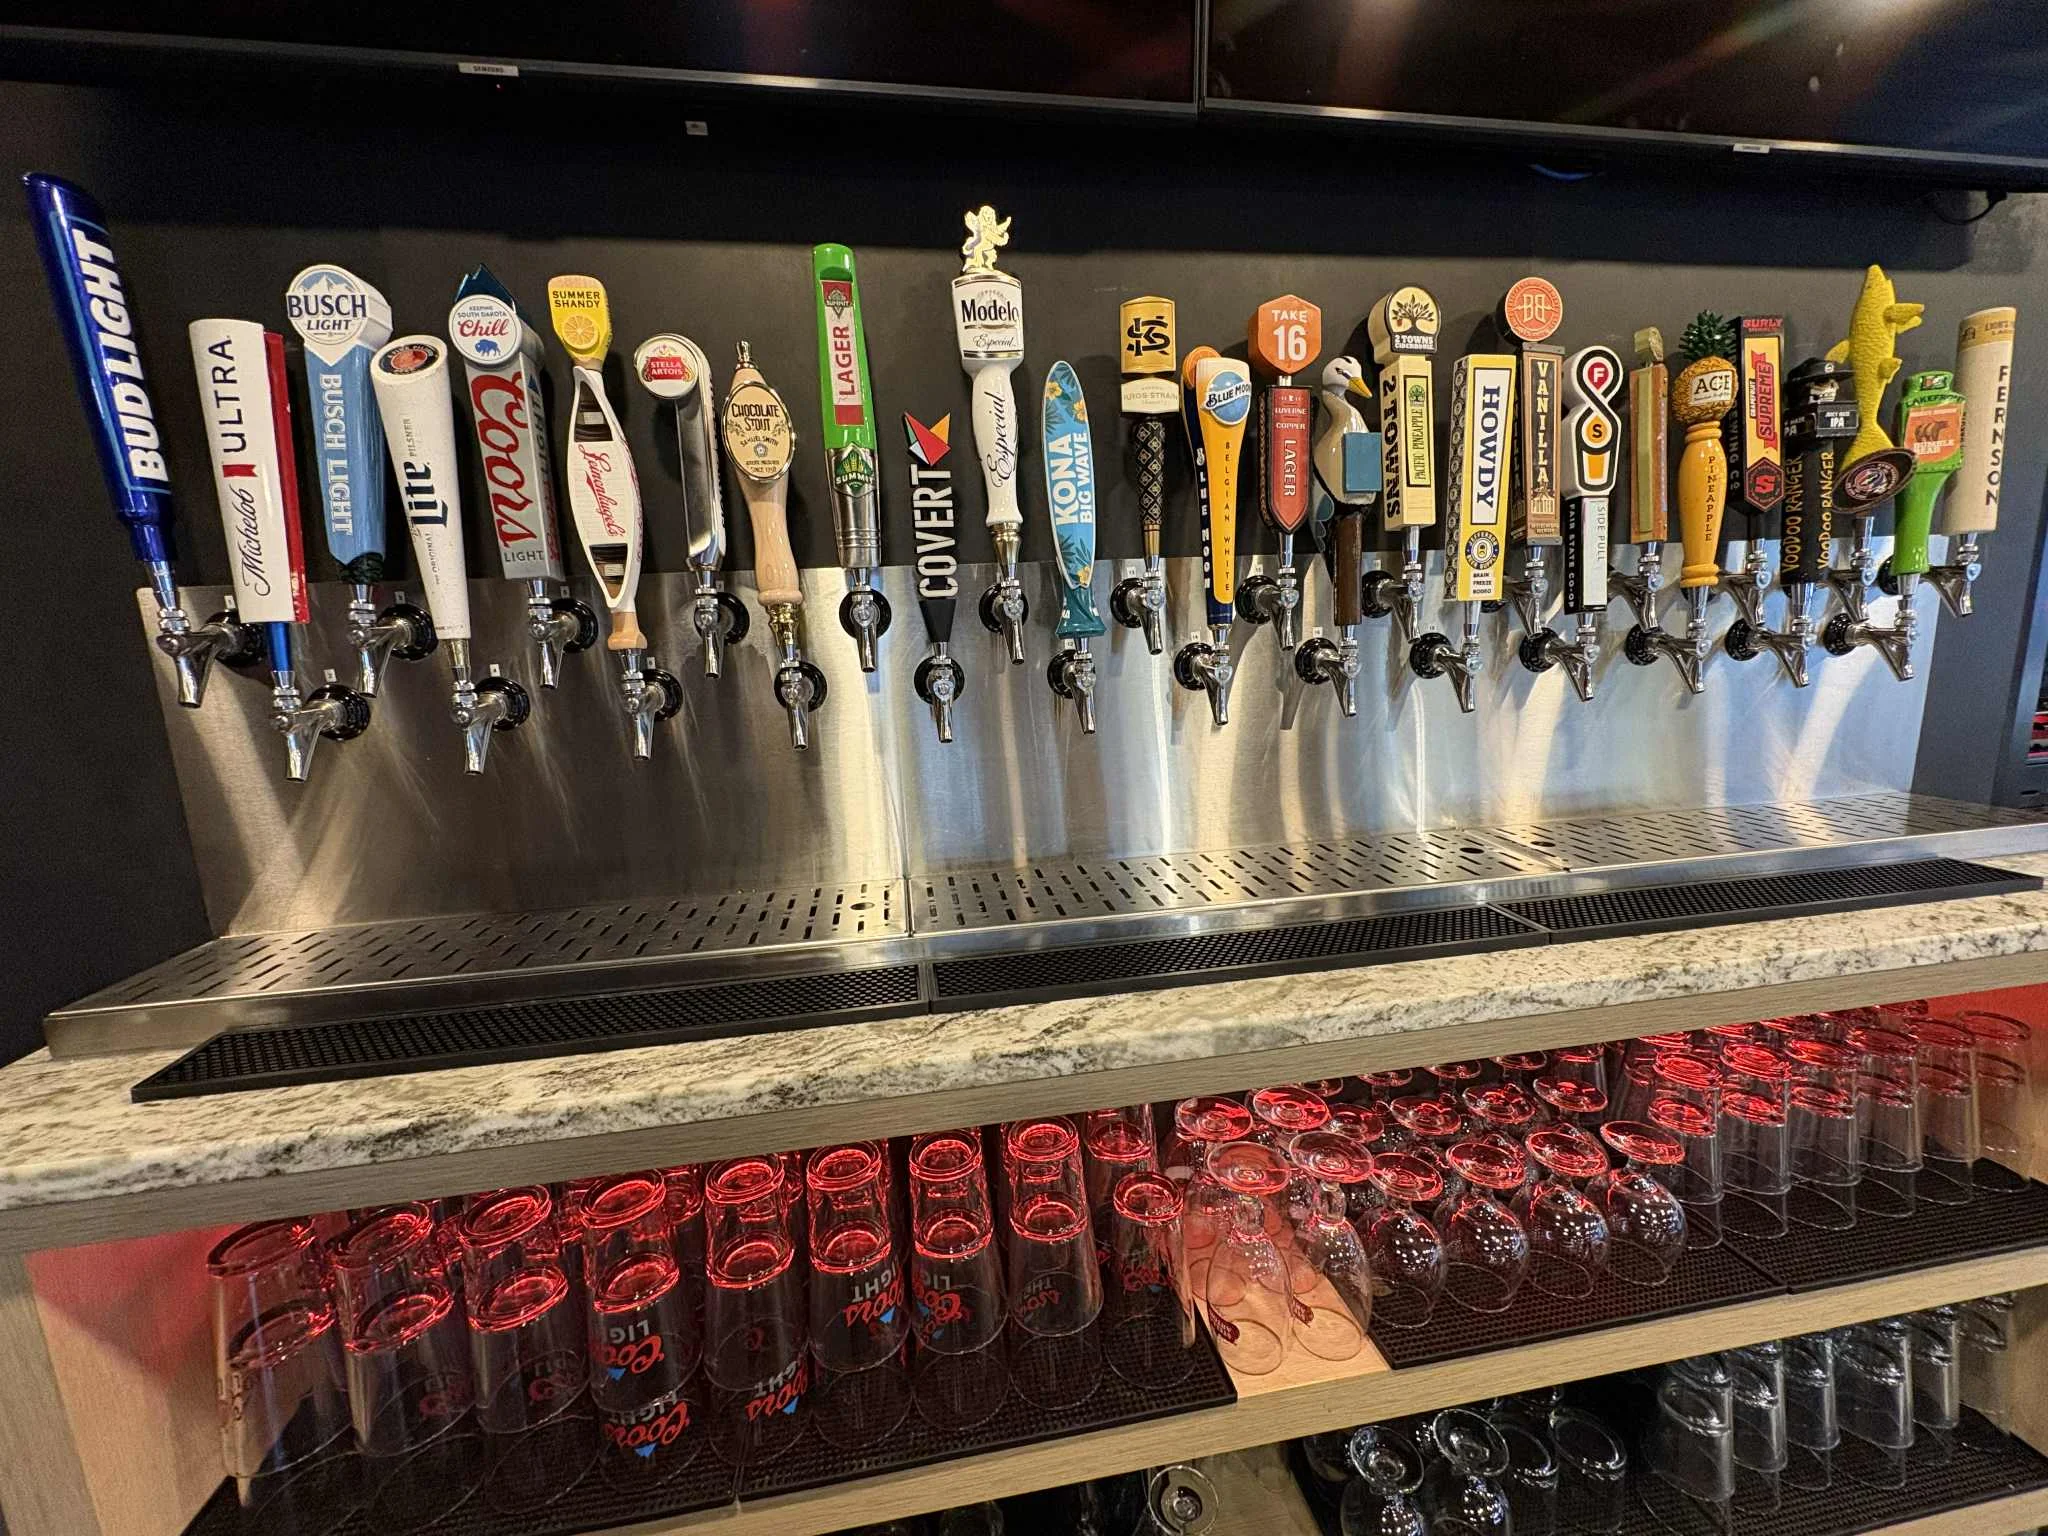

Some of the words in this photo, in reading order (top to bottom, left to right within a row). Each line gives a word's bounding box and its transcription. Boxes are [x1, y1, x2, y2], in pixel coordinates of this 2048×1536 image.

[73, 229, 146, 381] LIGHT
[287, 294, 368, 319] BUSCH
[552, 290, 601, 300] SUMMER
[554, 299, 601, 309] SHANDY
[1271, 310, 1308, 324] TAKE
[305, 318, 353, 332] LIGHT
[458, 319, 511, 338] Chill
[1273, 324, 1308, 362] 16
[1394, 334, 1401, 343] 2
[1401, 335, 1434, 345] TOWNS
[651, 361, 681, 369] STELLA
[651, 368, 683, 376] ARTOIS
[833, 326, 855, 397] LAGER
[1382, 375, 1397, 397] 2
[1593, 367, 1605, 382] F
[210, 336, 248, 454] ULTRA
[319, 373, 348, 451] BUSCH
[731, 403, 780, 418] CHOCOLATE
[1206, 389, 1234, 407] BLUE
[1537, 361, 1549, 483] VANILLA
[1759, 364, 1772, 437] SUPREME
[1830, 417, 1845, 427] IPA
[117, 382, 171, 483] BUD
[744, 417, 771, 432] STOUT
[984, 391, 1016, 488] Especial
[1276, 422, 1306, 430] COPPER
[1411, 409, 1425, 450] PINEAPPLE
[1477, 385, 1501, 509] HOWDY
[1592, 424, 1601, 438] S
[1986, 365, 2008, 506] FERNSON
[471, 371, 538, 548] Coors
[836, 472, 874, 485] SUMMIT
[1049, 433, 1079, 525] KONA
[1072, 433, 1090, 490] WAVE
[1197, 448, 1208, 516] BLUE
[1284, 439, 1297, 497] LAGER
[1383, 400, 1401, 518] TOWNS
[1413, 453, 1426, 480] PACIFIC
[1784, 453, 1804, 512] RANGER
[1821, 451, 1834, 510] RANGER
[326, 458, 354, 536] LIGHT
[404, 462, 449, 528] Lite
[1077, 491, 1091, 523] BIG
[1597, 506, 1606, 530] SIDE
[1705, 456, 1716, 542] PINEAPPLE
[239, 488, 260, 597] Michelob
[504, 549, 546, 562] LIGHT
[911, 464, 958, 598] COVERT
[1202, 528, 1211, 589] MOON
[1597, 535, 1605, 561] PULL
[1783, 513, 1802, 573] VOODOO
[1817, 512, 1832, 569] VOODOO
